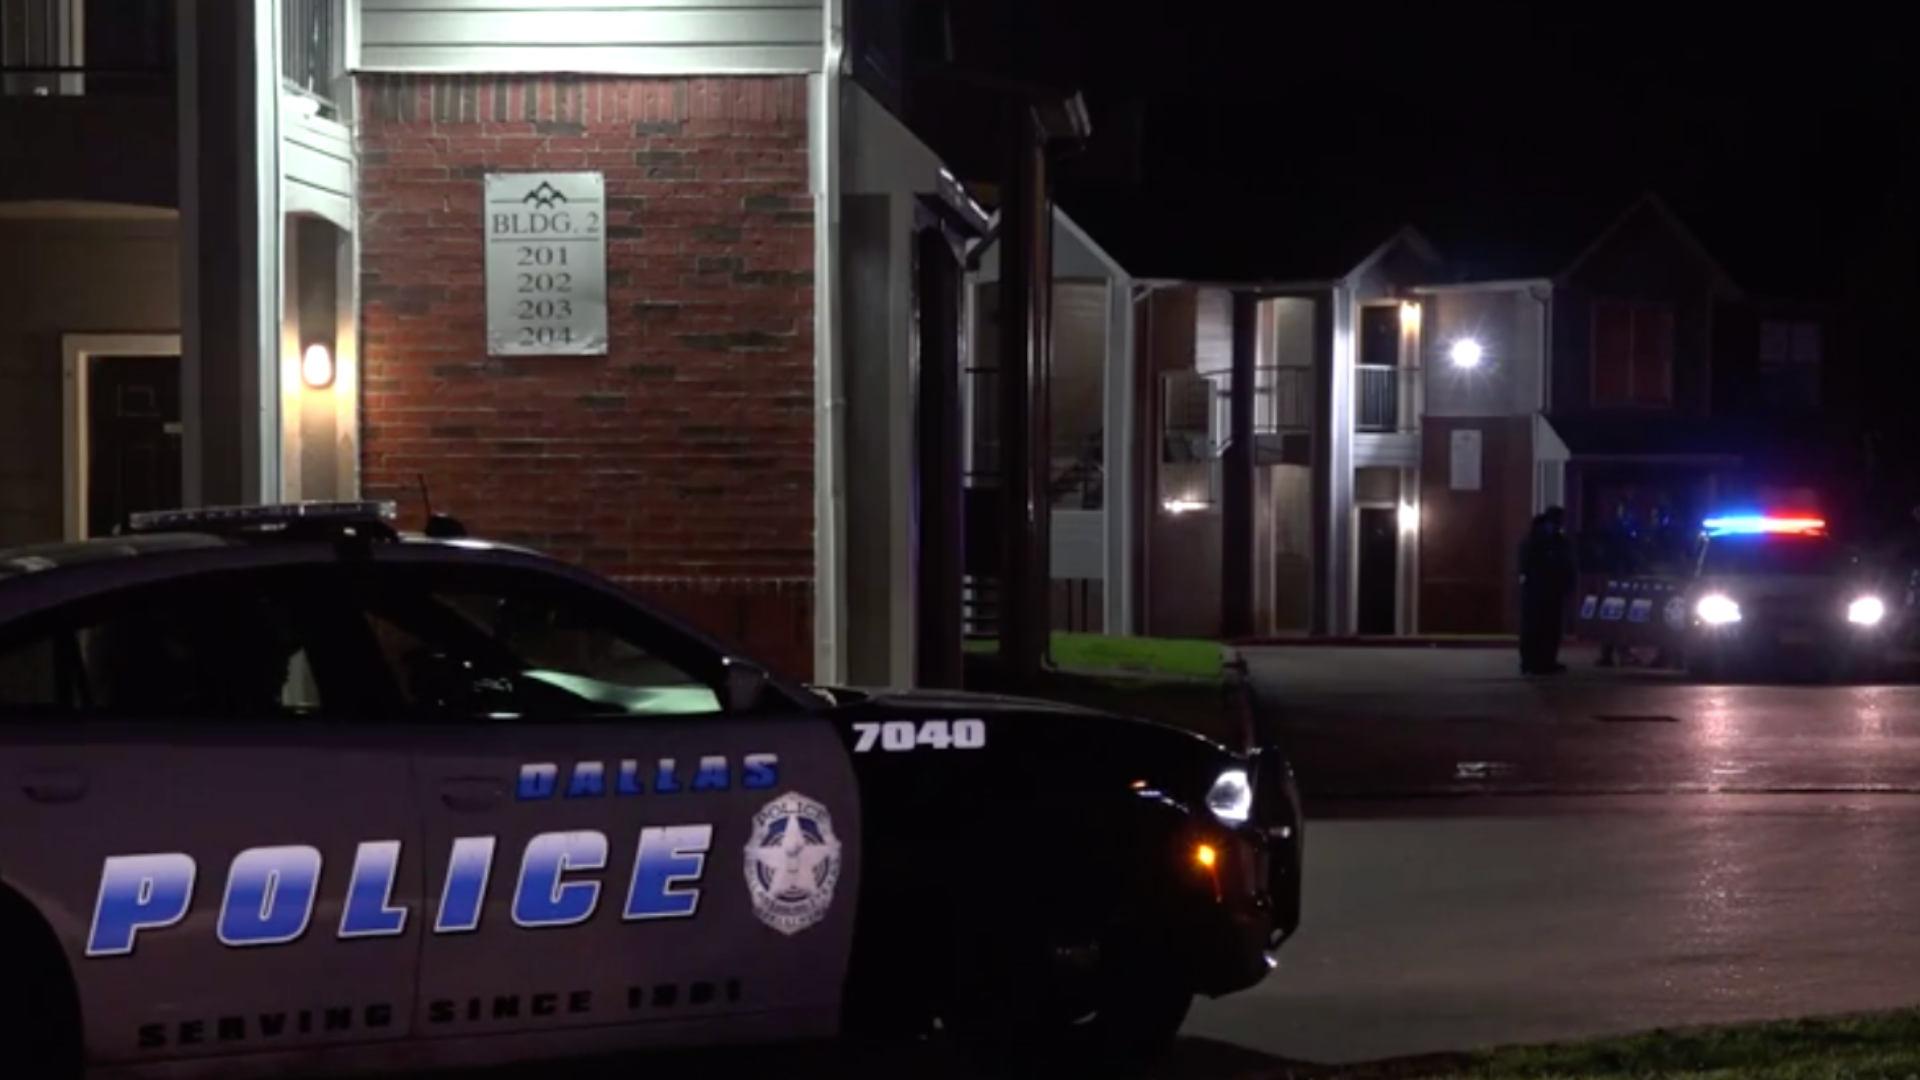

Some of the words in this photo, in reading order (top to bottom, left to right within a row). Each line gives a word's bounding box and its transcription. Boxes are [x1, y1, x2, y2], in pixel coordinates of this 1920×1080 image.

[493, 212, 578, 234] BLDG.
[586, 211, 599, 233] 2
[517, 246, 568, 266] 201
[517, 273, 572, 293] 202
[517, 300, 572, 320] 203
[518, 326, 573, 346] 204
[852, 718, 986, 753] 7040
[515, 752, 779, 801] DALLAS
[84, 823, 714, 958] POLICE
[138, 1004, 393, 1049] SERVING
[428, 990, 593, 1023] SINCE
